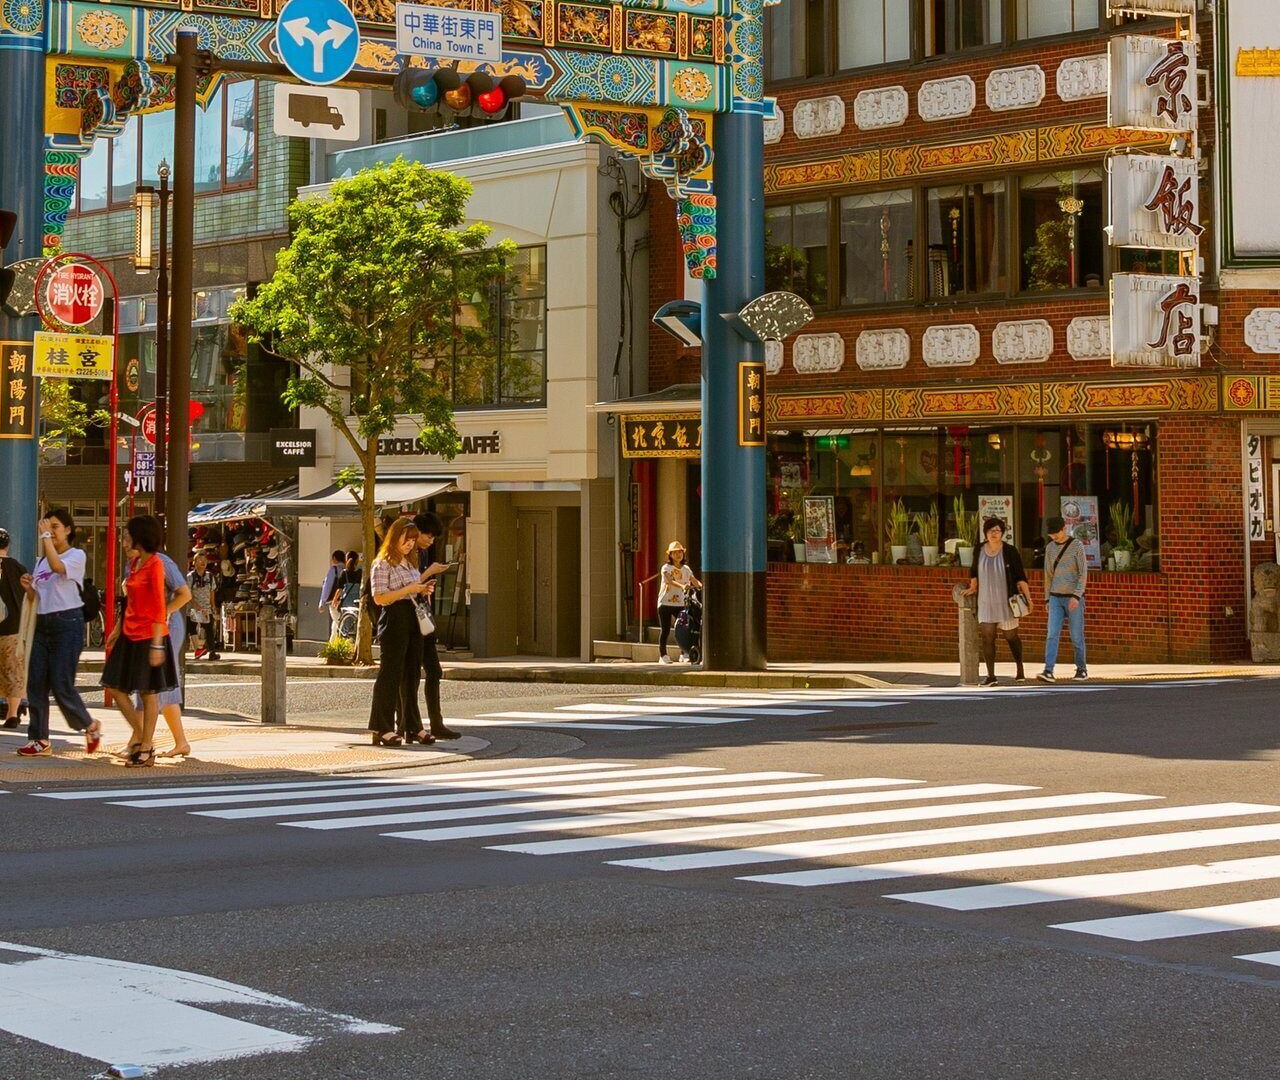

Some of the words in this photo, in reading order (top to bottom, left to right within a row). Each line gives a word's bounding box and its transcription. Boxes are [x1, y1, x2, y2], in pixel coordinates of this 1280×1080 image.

[404, 11, 494, 41] 中華街東門
[413, 36, 441, 50] China
[447, 40, 474, 53] Town
[53, 282, 99, 307] 消火栓
[8, 350, 28, 426] 朝陽門
[747, 371, 761, 435] 朝陽門
[458, 431, 500, 455] AFFÉ
[1247, 435, 1264, 539] タピオカ
